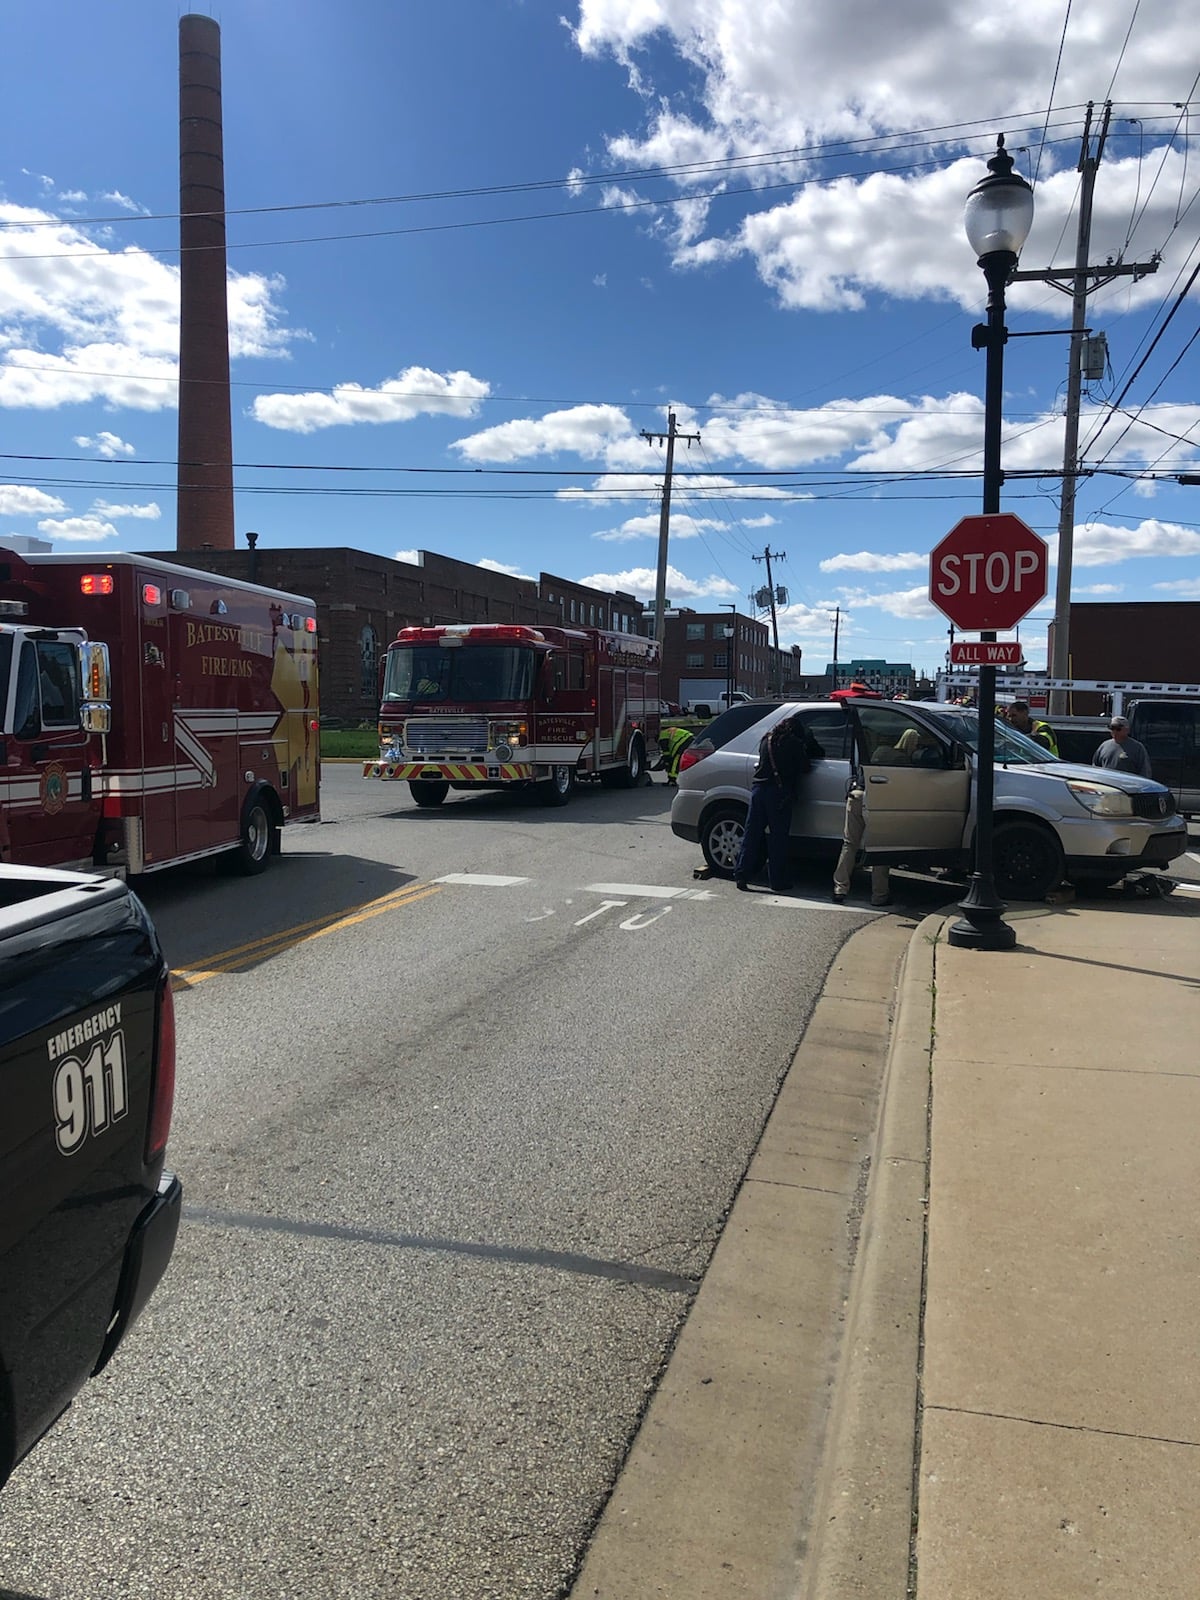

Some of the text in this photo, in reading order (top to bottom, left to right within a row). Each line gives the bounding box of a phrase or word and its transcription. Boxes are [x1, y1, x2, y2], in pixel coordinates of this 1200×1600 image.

[938, 550, 1040, 596] STOP
[186, 622, 264, 653] BATESVILLE
[201, 655, 253, 678] FIRE/EMS
[957, 647, 1014, 660] ALL WAY
[538, 717, 577, 727] BATESVILLE
[47, 1002, 122, 1061] EMERGENCY
[53, 1030, 128, 1155] 911
